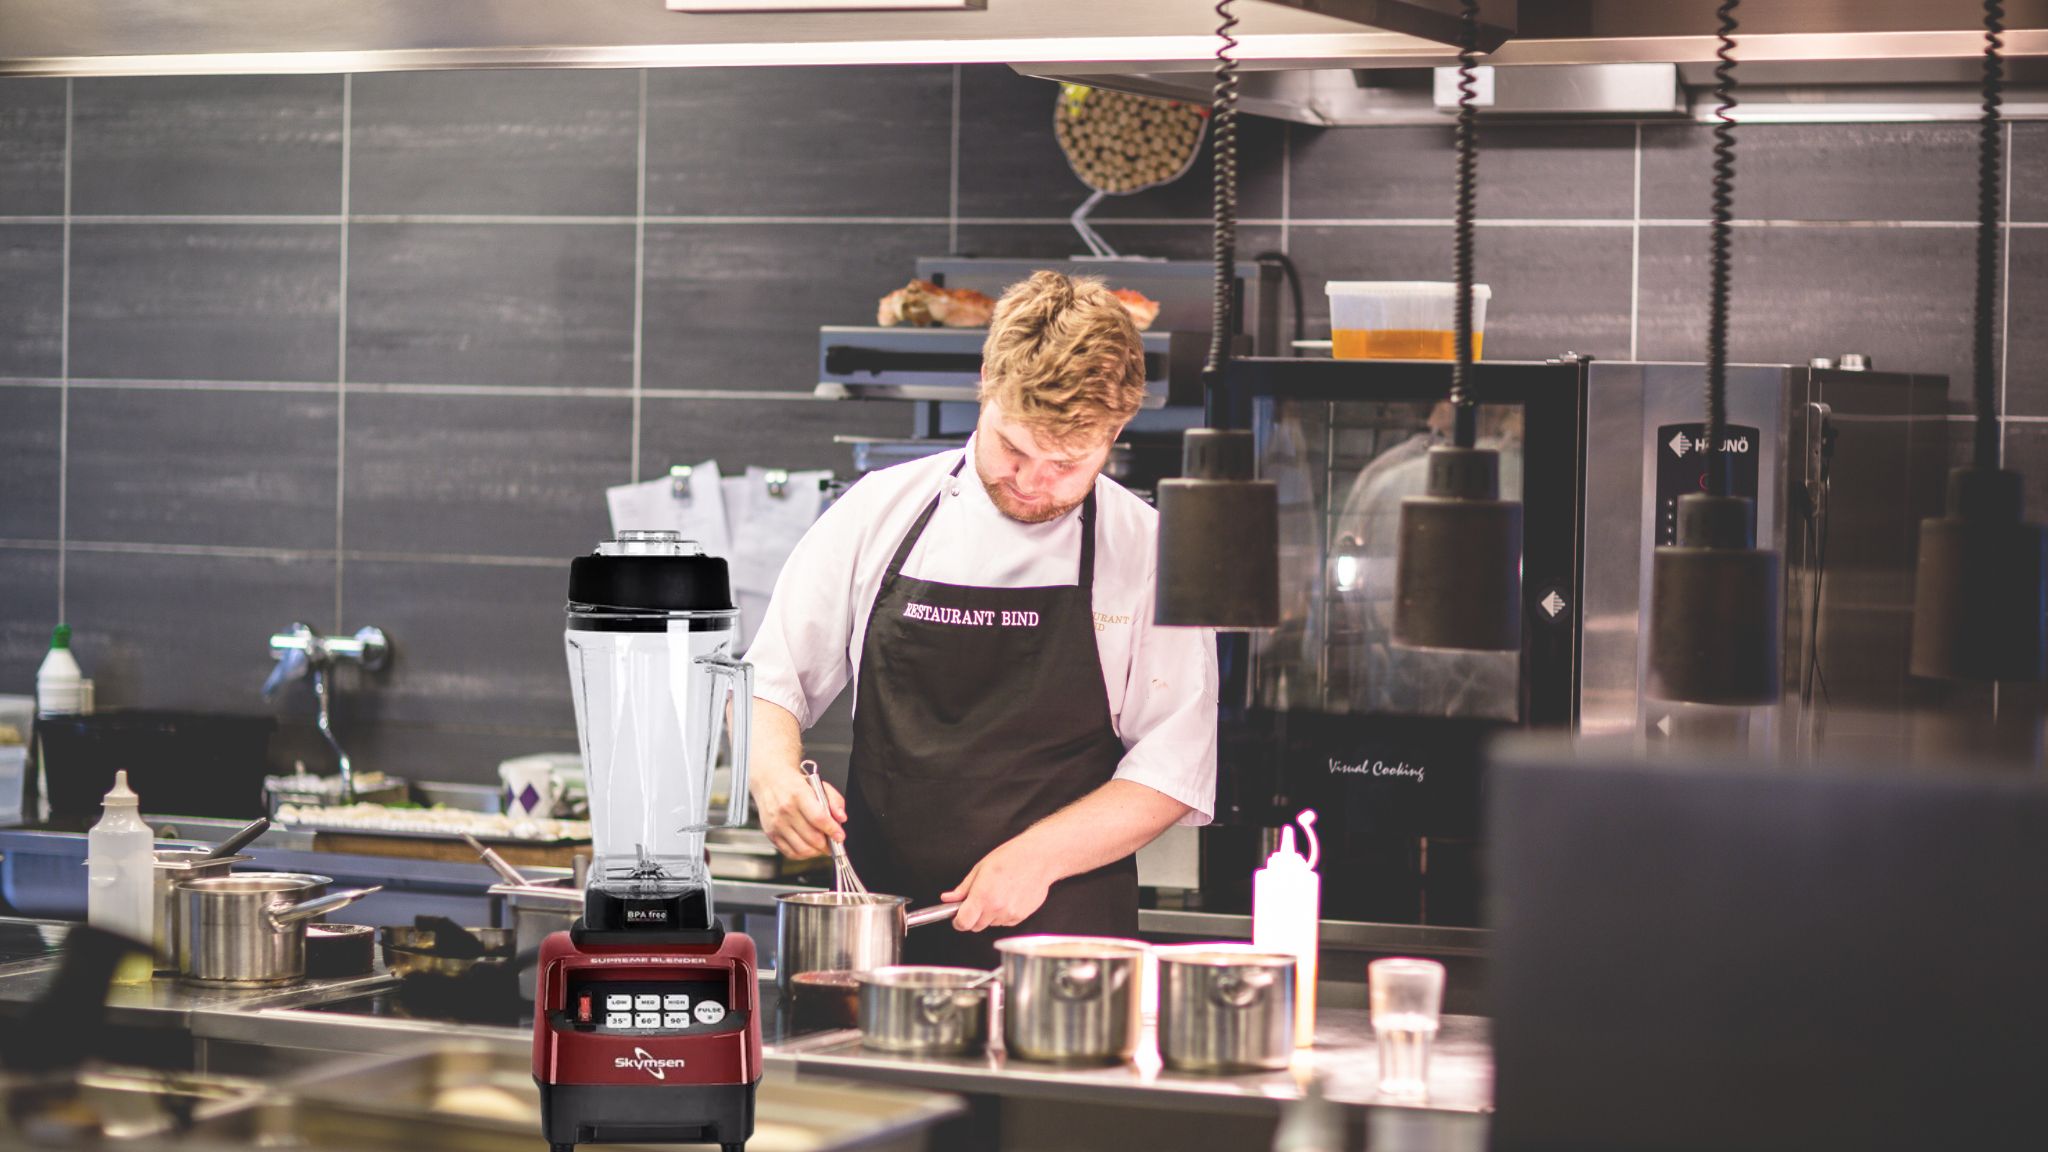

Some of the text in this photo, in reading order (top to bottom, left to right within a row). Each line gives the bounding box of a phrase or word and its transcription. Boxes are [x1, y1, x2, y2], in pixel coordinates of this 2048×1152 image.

[903, 602, 1039, 626] RESTAURANT BIND
[1328, 758, 1424, 782] Visual Cooking
[627, 910, 667, 919] BPA free
[615, 1057, 685, 1070] Skymsen
